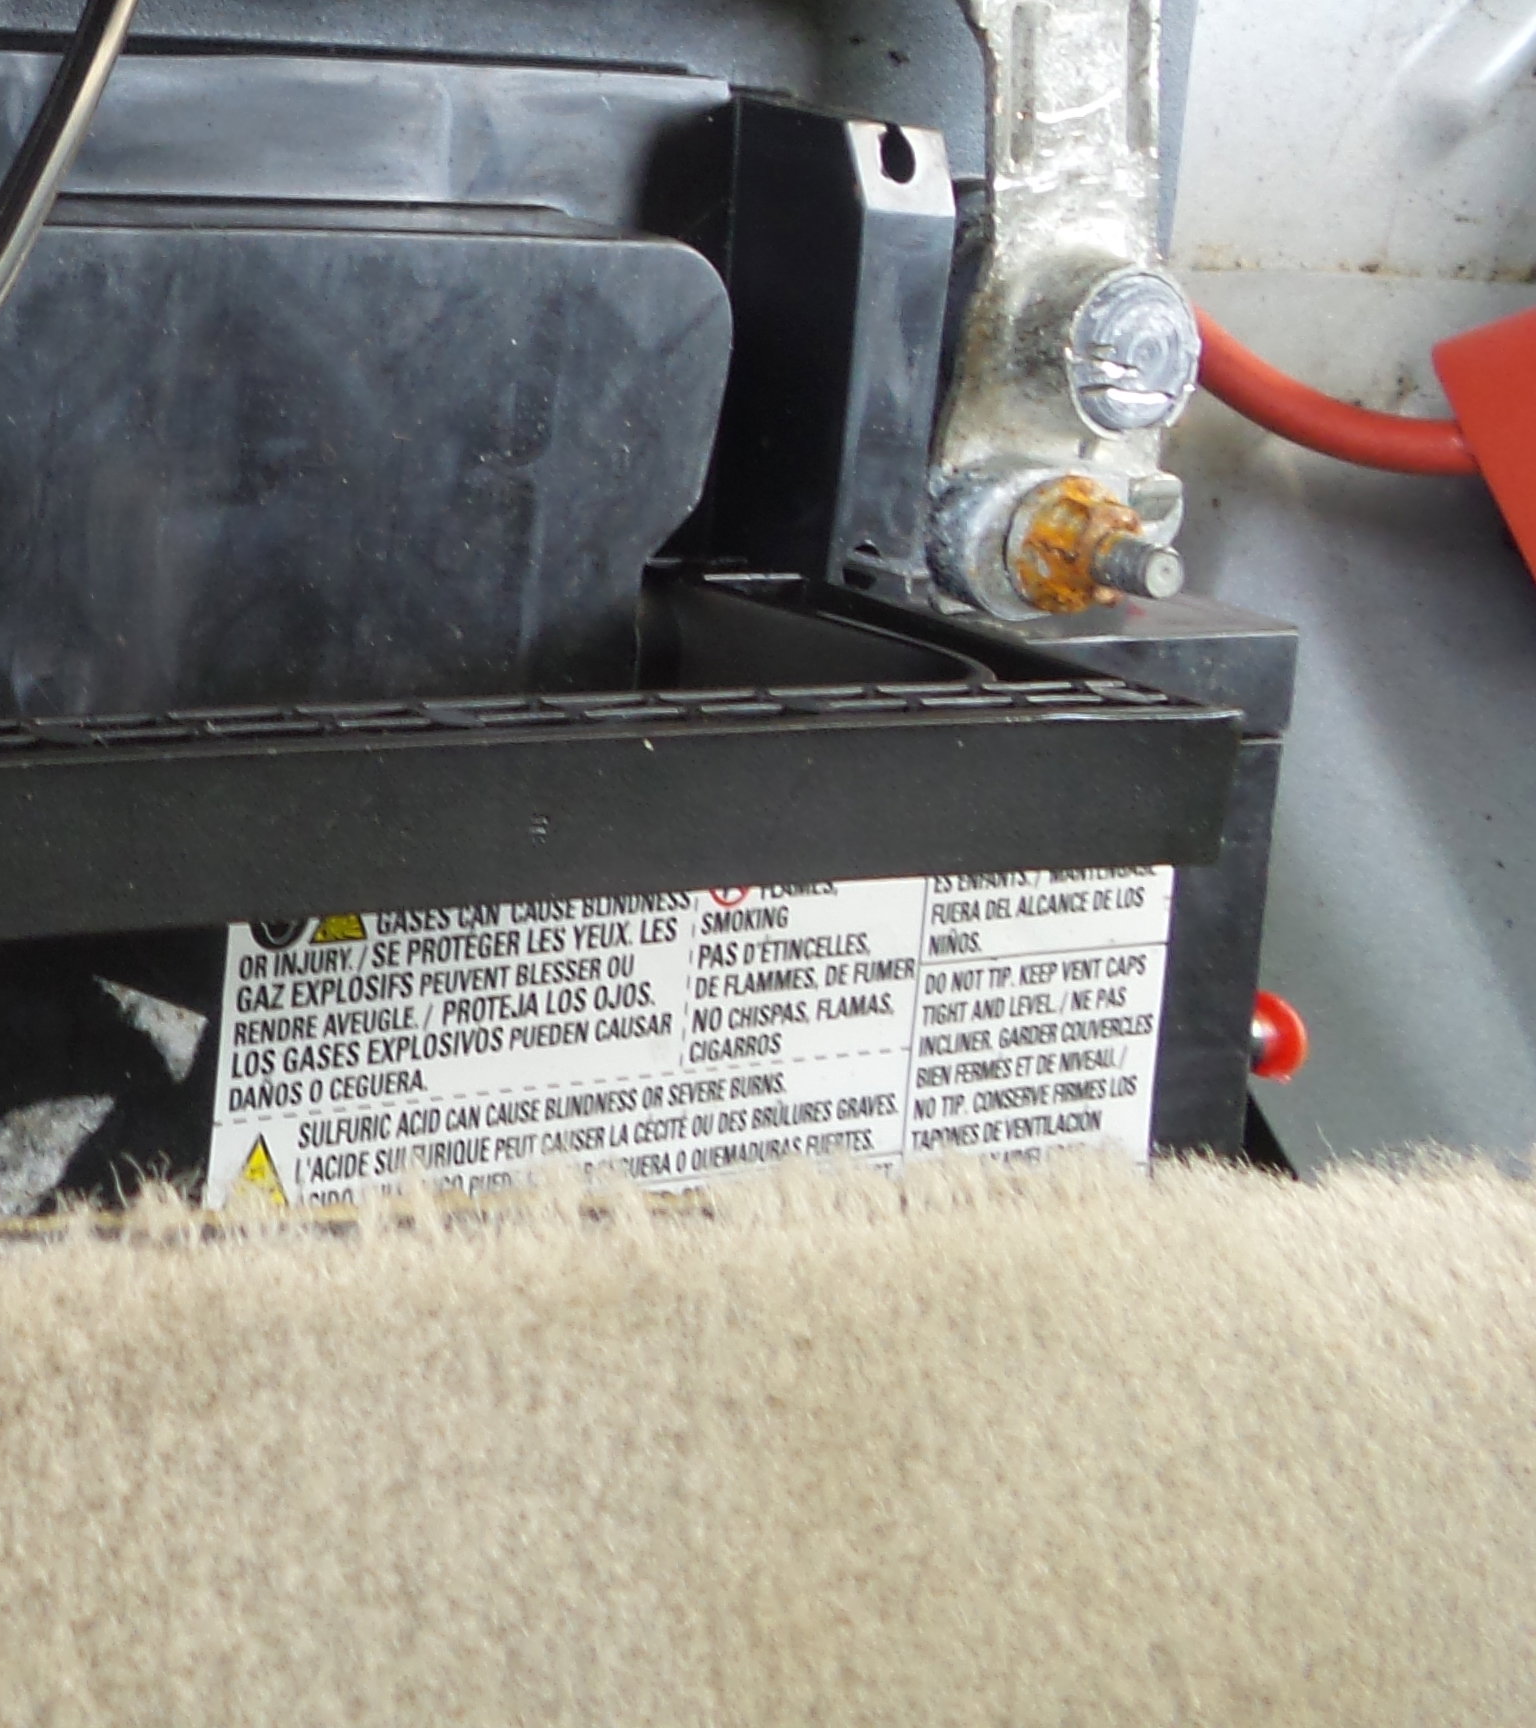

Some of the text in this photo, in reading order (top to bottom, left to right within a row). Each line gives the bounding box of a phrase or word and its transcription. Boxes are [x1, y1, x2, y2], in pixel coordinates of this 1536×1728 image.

[375, 894, 693, 934] GASES CAN CAUSE BLINDNESS
[701, 906, 788, 934] SMOKING
[931, 886, 1144, 924] FUERA DEL ALCANCE DE LOS
[239, 954, 267, 980] OR
[274, 948, 351, 976] INJURY.
[372, 941, 400, 967] SE
[527, 927, 565, 953] LES
[640, 916, 677, 944] LES
[698, 942, 737, 969] PAS
[929, 931, 981, 955] NIÑOS.
[236, 954, 633, 1012] GAZ EXPLOSIFS PEUVENT BLESSER OU
[695, 975, 718, 999] DE
[825, 964, 847, 986] DE
[853, 958, 914, 983] FUMER
[925, 972, 946, 994] DO
[951, 969, 983, 991] NOT
[1019, 963, 1057, 984] KEEP
[1062, 959, 1101, 981] VENT
[1106, 956, 1146, 977] CAPS
[234, 982, 654, 1046] RENDRE AVEUGLE. PROTEJA LOS OJOS.
[692, 993, 898, 1033] NO CHISPAS, FLAMAS,
[922, 1001, 967, 1025] TIGHT
[971, 998, 1004, 1019] AND
[1071, 990, 1091, 1010] NE
[1096, 987, 1126, 1008] PAS
[231, 1013, 671, 1078] LOS GASES EXPLOSIVOS PUEDEN CAUSAR
[689, 1033, 781, 1063] CIGARROS
[998, 1023, 1057, 1048] GARDER
[1061, 1014, 1157, 1042] COUVERCLES
[229, 1081, 302, 1111] DAÑOS
[330, 1070, 426, 1100] CEGUERA.
[916, 1065, 951, 1088] BIEN
[1015, 1055, 1033, 1076] ET
[1036, 1053, 1055, 1075] DE
[298, 1073, 787, 1149] SULFURIC ACID CAN CAUSE BLINDNESS OR SEVERE BURNS.
[914, 1098, 935, 1119] NO
[973, 1085, 1048, 1112] CONSERVE
[1053, 1079, 1106, 1102] FIRMES
[1110, 1076, 1136, 1097] LOS
[295, 1151, 368, 1183] L'ACIDE
[494, 1134, 536, 1160] PEUT
[609, 1123, 627, 1146] LA
[692, 1114, 713, 1137] OU
[718, 1109, 746, 1133] DES
[836, 1093, 897, 1119] GRAVES.
[983, 1120, 1002, 1142] DE
